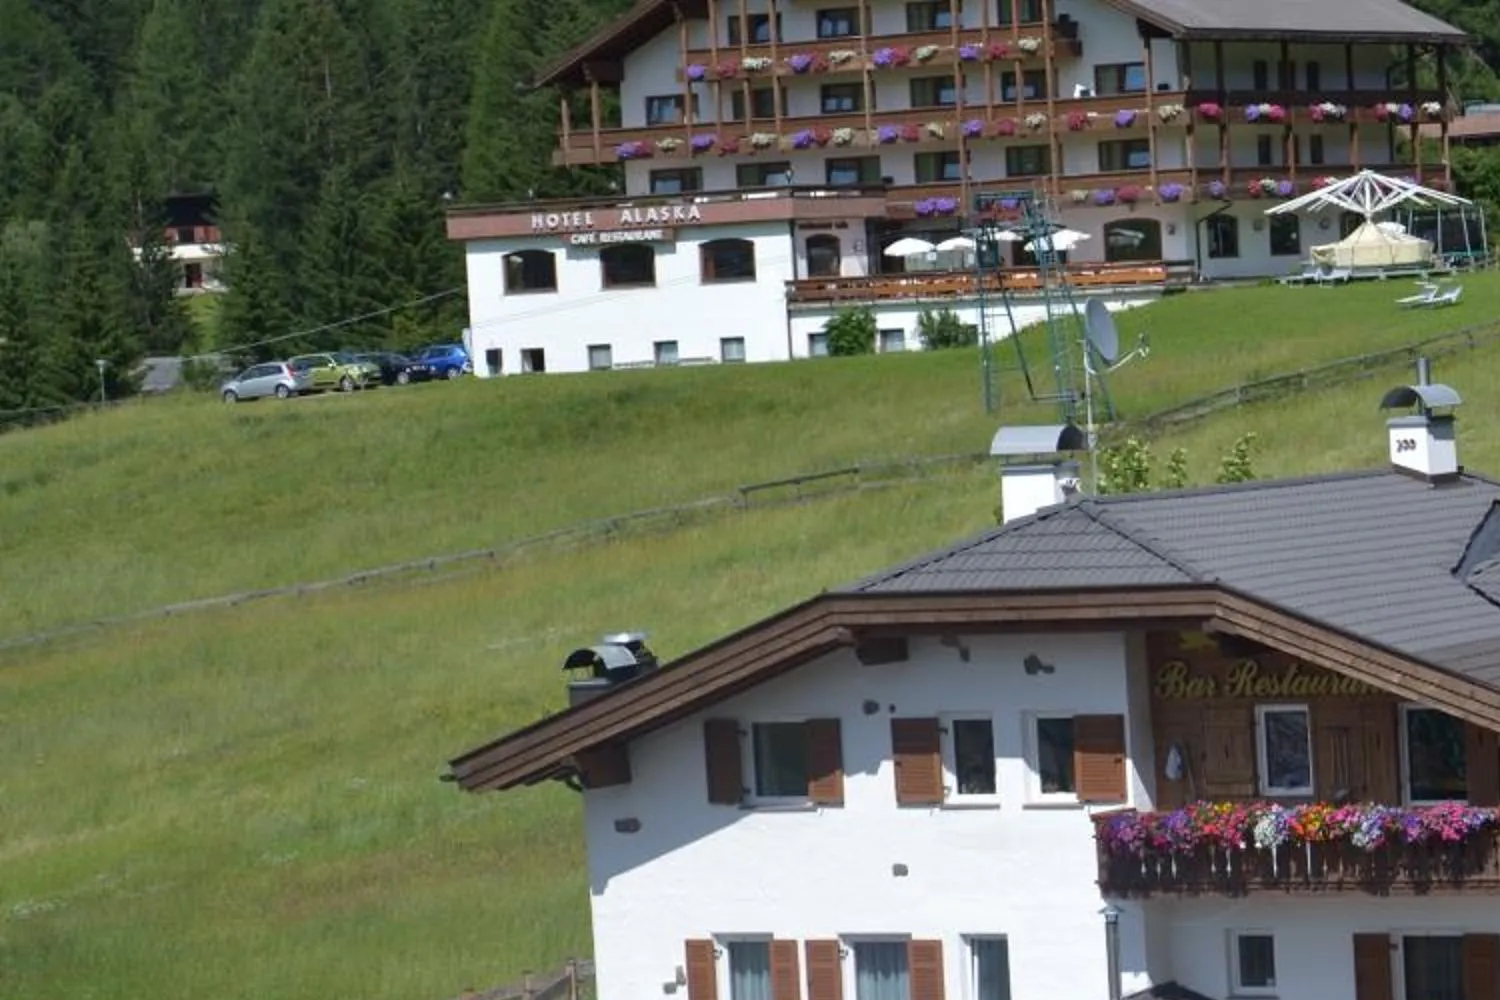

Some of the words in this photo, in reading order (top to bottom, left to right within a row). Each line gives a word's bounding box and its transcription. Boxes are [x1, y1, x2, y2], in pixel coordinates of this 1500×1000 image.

[531, 211, 594, 229] HOTEL
[620, 205, 701, 223] ALASKA
[1155, 660, 1217, 699] Bar
